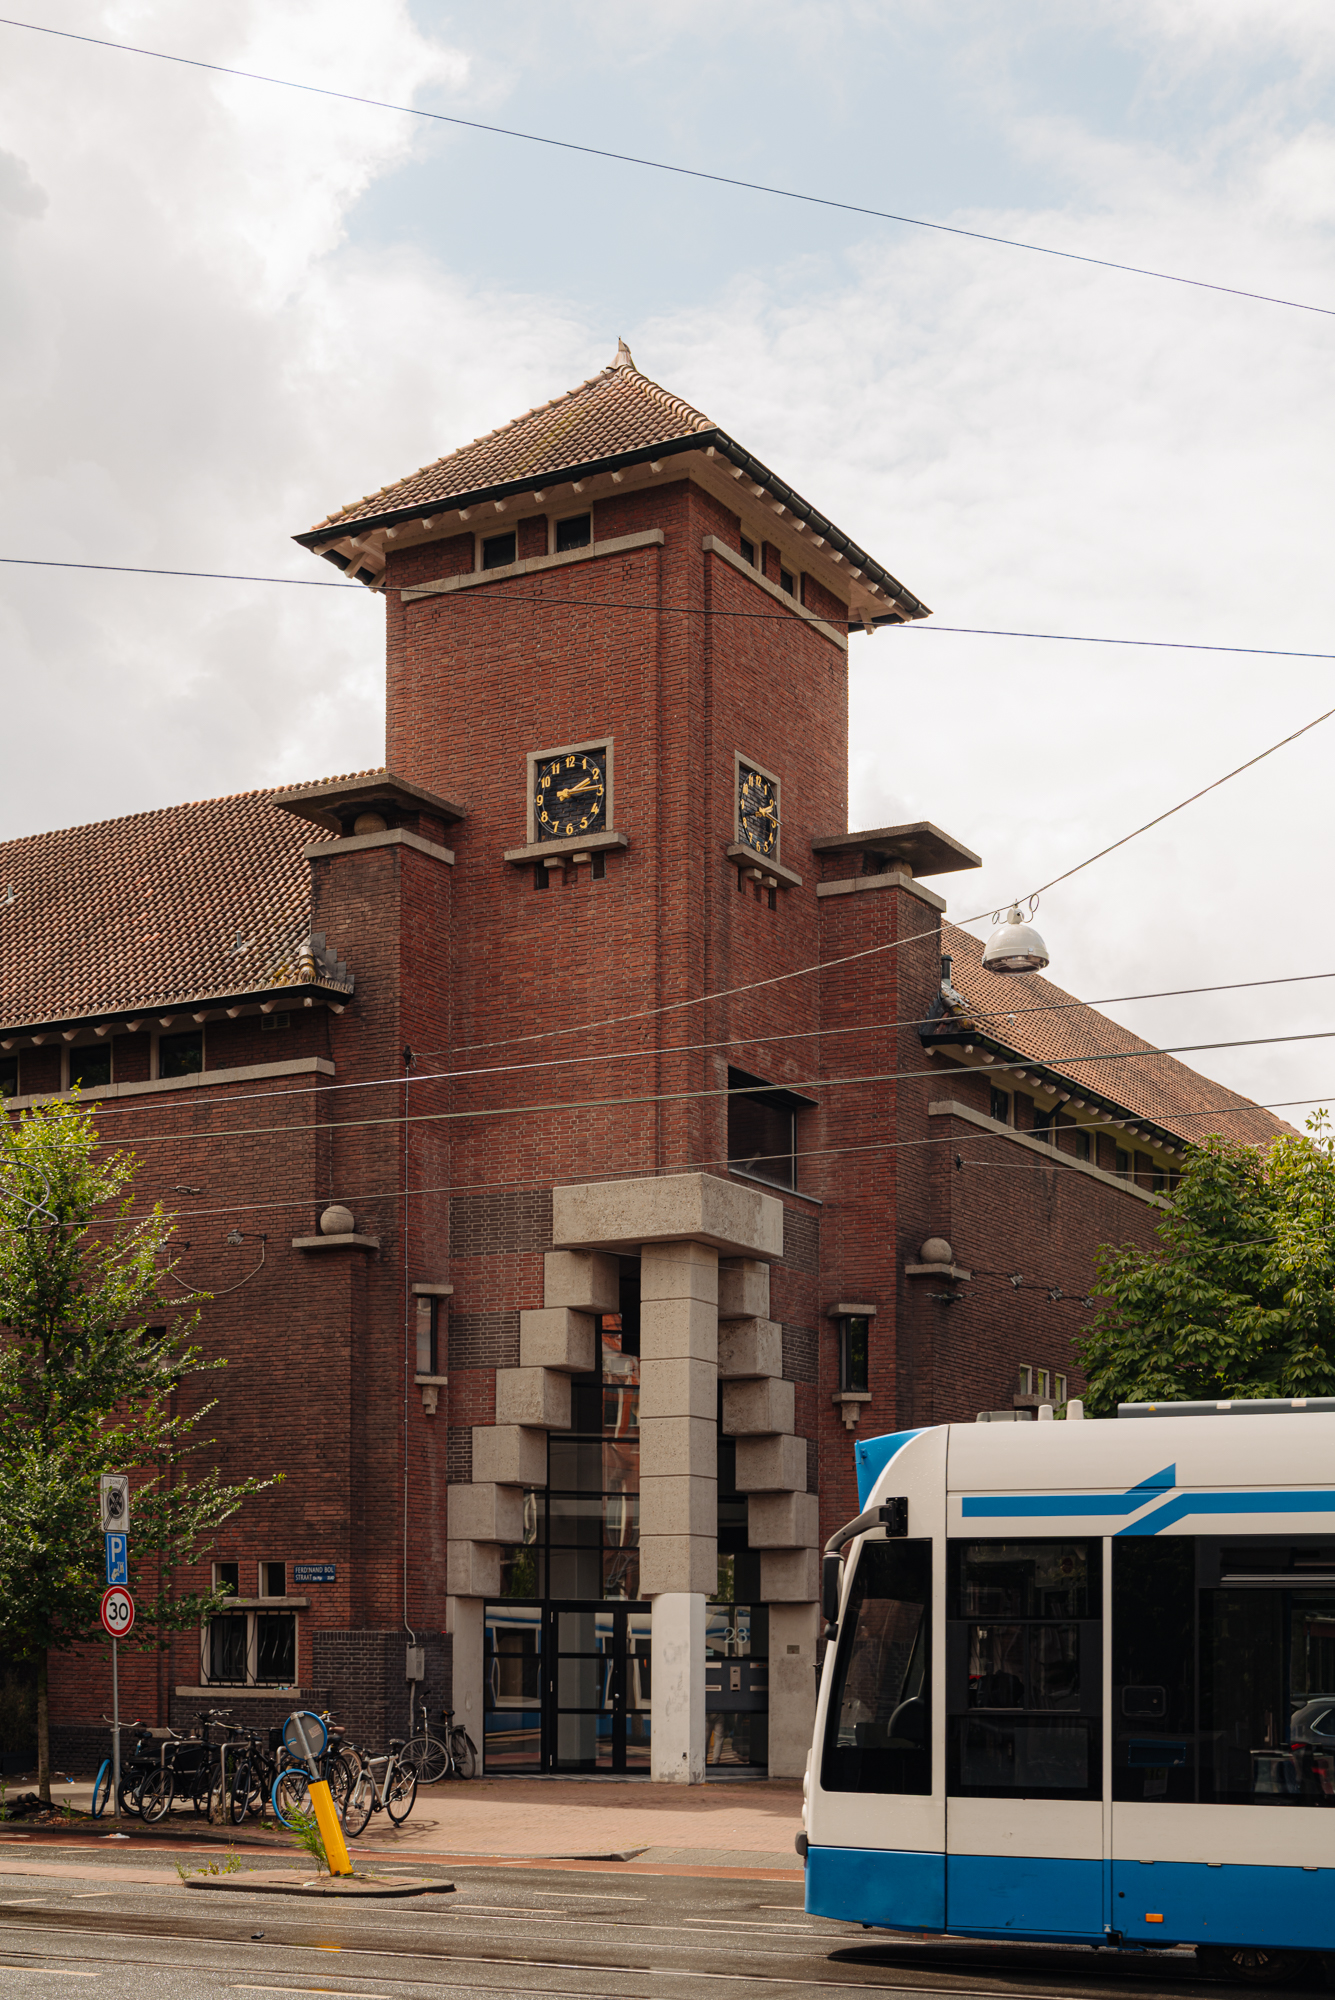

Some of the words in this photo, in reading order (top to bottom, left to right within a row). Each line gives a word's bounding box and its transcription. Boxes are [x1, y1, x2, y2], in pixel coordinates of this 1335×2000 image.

[565, 756, 576, 768] 12
[582, 758, 587, 770] 1
[551, 762, 560, 775] 11
[592, 768, 600, 780] 2
[541, 776, 551, 788] 10
[749, 775, 754, 787] 11
[756, 775, 762, 787] 12
[596, 784, 604, 796] 3
[764, 784, 768, 795] 1
[536, 795, 544, 806] 9
[591, 802, 599, 814] 4
[541, 811, 548, 822] 8
[580, 817, 588, 828] 5
[743, 817, 747, 828] 8
[552, 821, 559, 833] 7
[566, 823, 573, 835] 6
[749, 832, 753, 843] 7
[769, 832, 773, 844] 4
[756, 841, 760, 852] 6
[763, 841, 768, 852] 5
[111, 1537, 122, 1562] P
[109, 1602, 128, 1621] 30
[724, 1627, 748, 1643] 23
